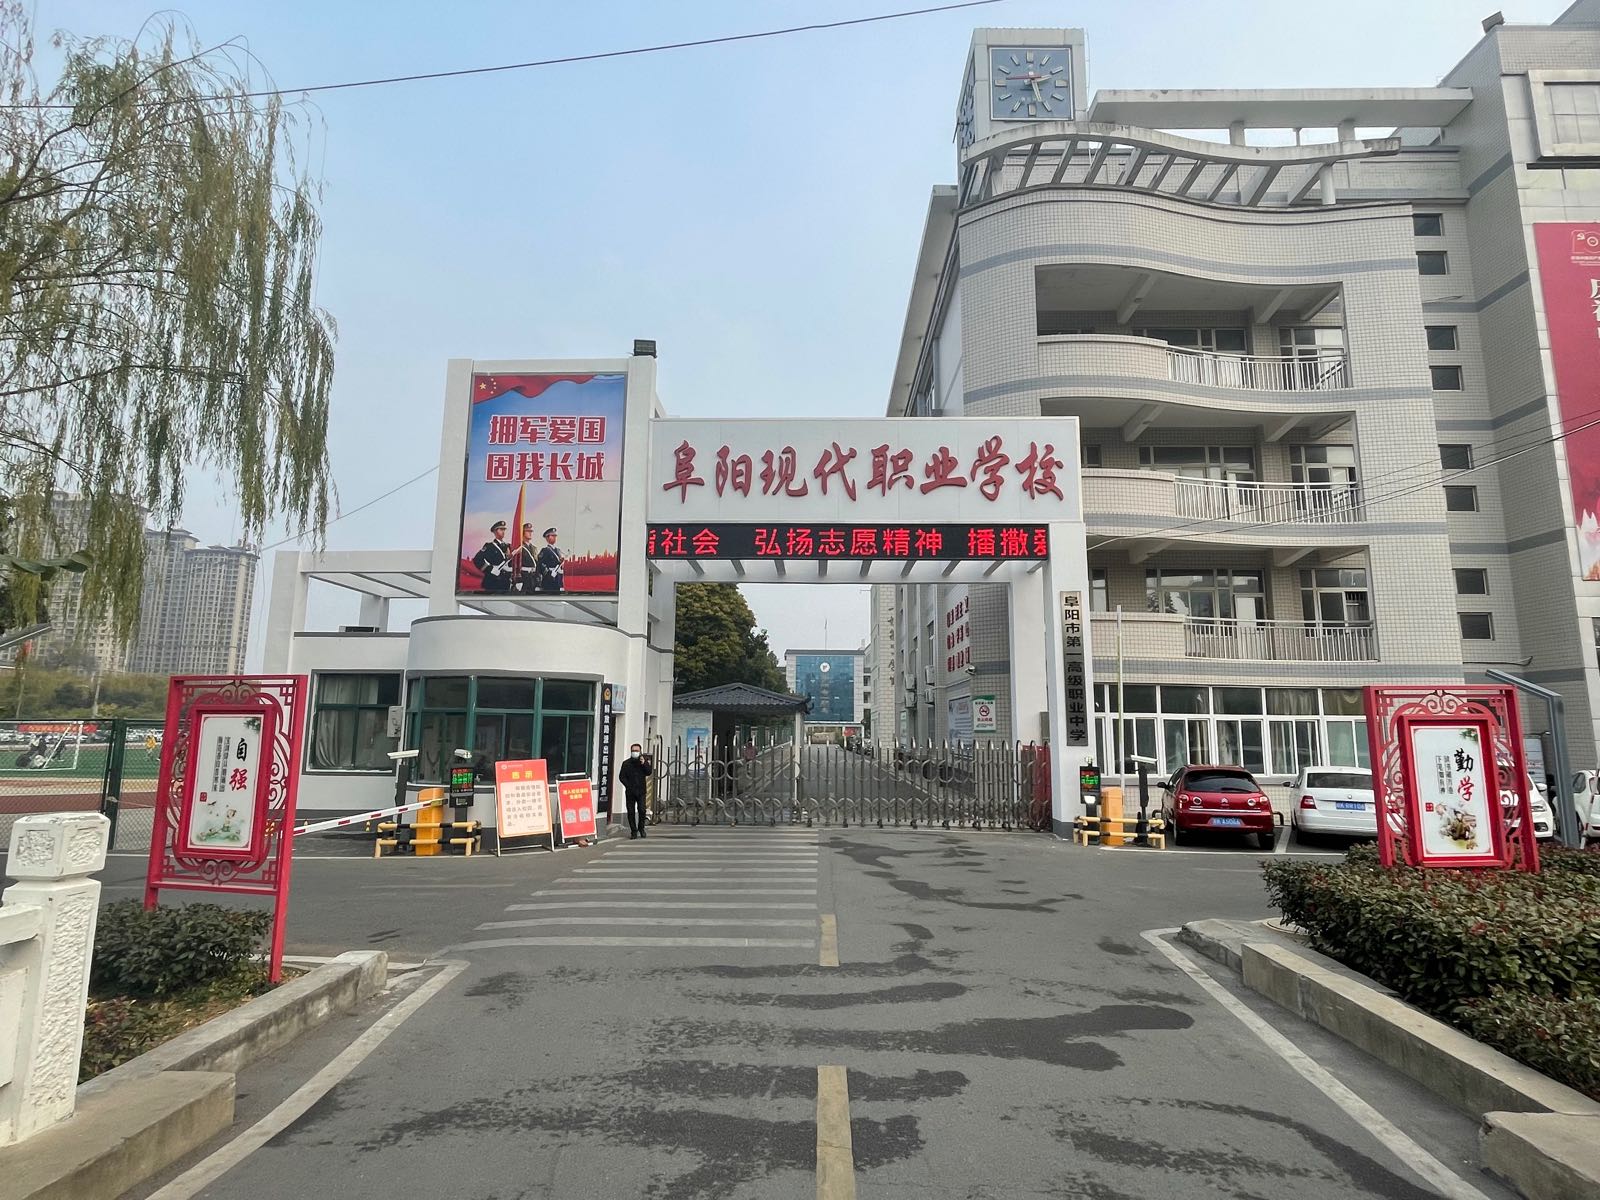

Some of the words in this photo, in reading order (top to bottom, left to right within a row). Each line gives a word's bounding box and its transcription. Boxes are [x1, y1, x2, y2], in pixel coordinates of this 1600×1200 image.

[488, 415, 606, 444] 拥军爱国
[485, 452, 605, 482] 固我长城
[662, 435, 1065, 504] 阜阳现代职业学校
[754, 528, 943, 557] 弘扬志愿精神
[1064, 595, 1086, 741] 阜阳市第一高级职业中学
[229, 737, 248, 791] 自强
[1453, 747, 1475, 801] 勤学
